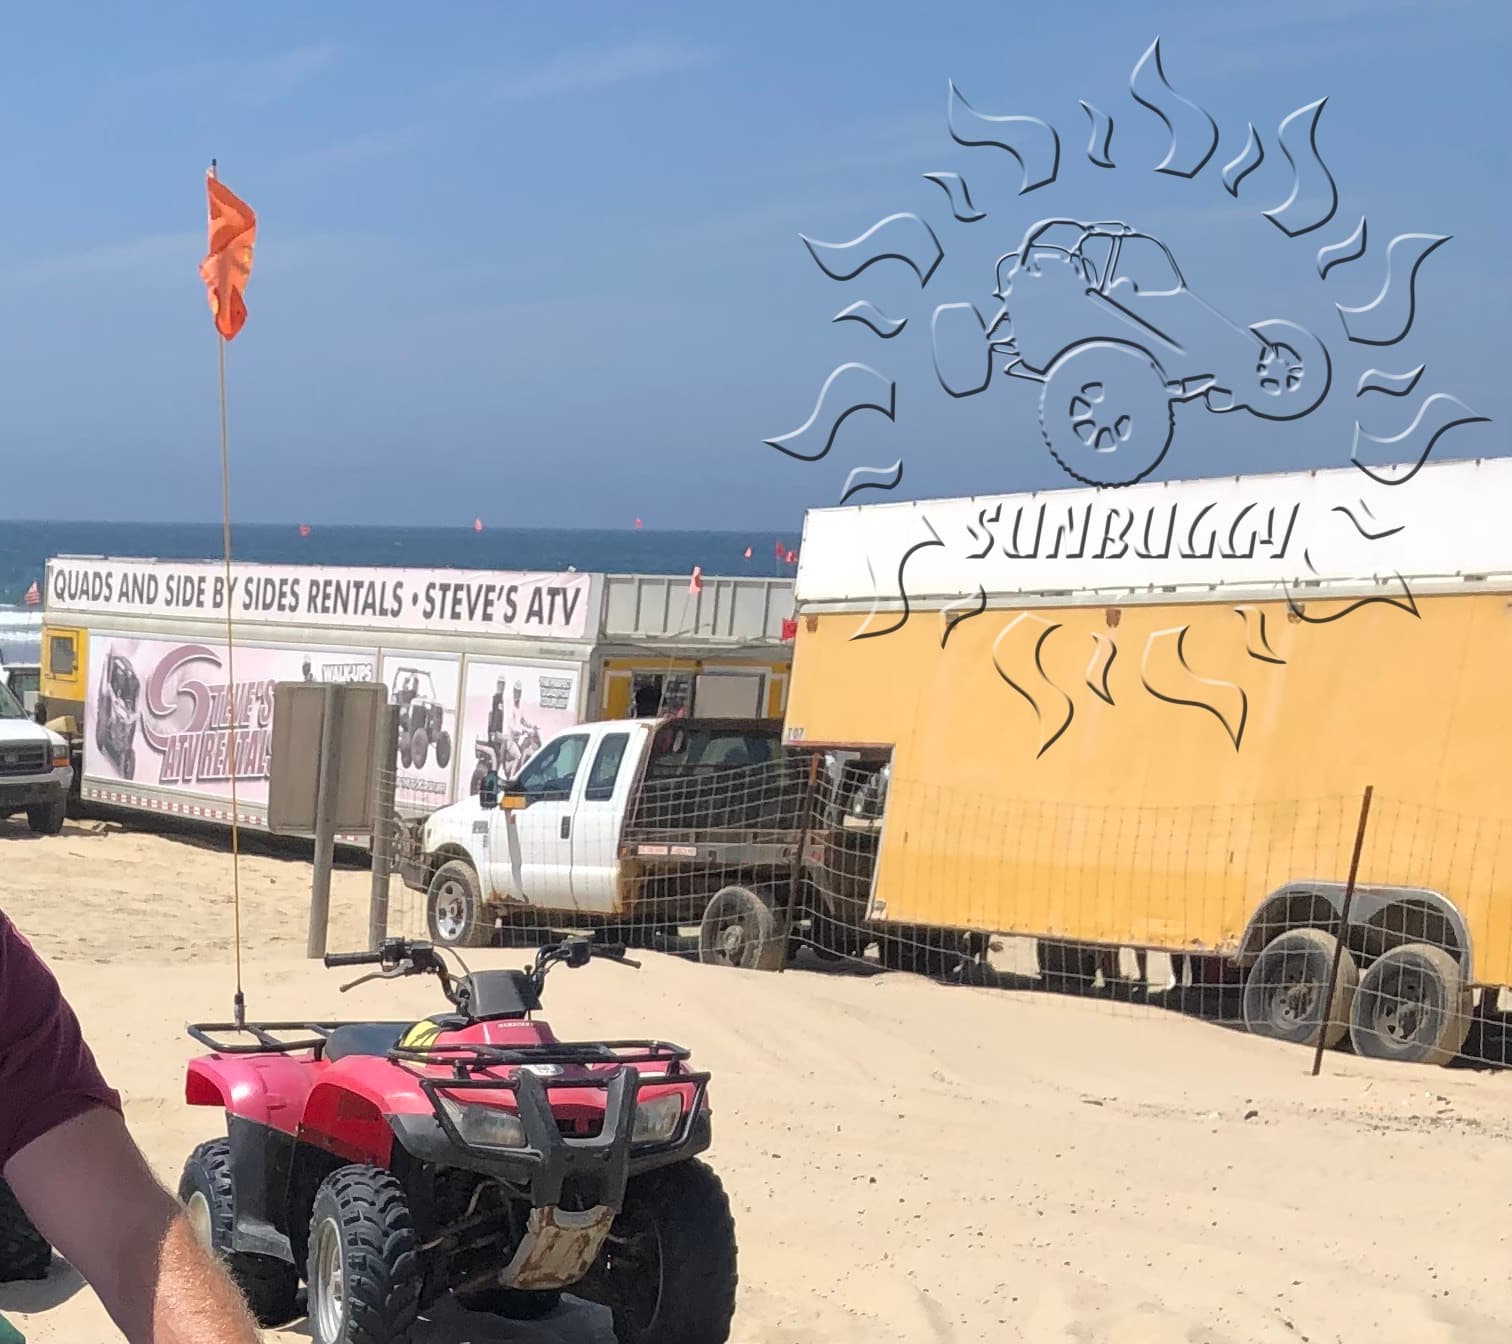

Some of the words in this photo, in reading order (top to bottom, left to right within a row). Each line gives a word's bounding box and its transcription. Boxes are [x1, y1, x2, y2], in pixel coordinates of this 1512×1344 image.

[53, 568, 113, 602] QUADS
[118, 571, 159, 605] AND
[164, 573, 206, 608] SIDE
[212, 575, 238, 610] BY
[243, 576, 301, 613] SIDES
[307, 578, 404, 618] RENTALS
[422, 581, 519, 624] STEVE'S
[524, 586, 582, 626] ATV
[160, 731, 205, 784] ATV
